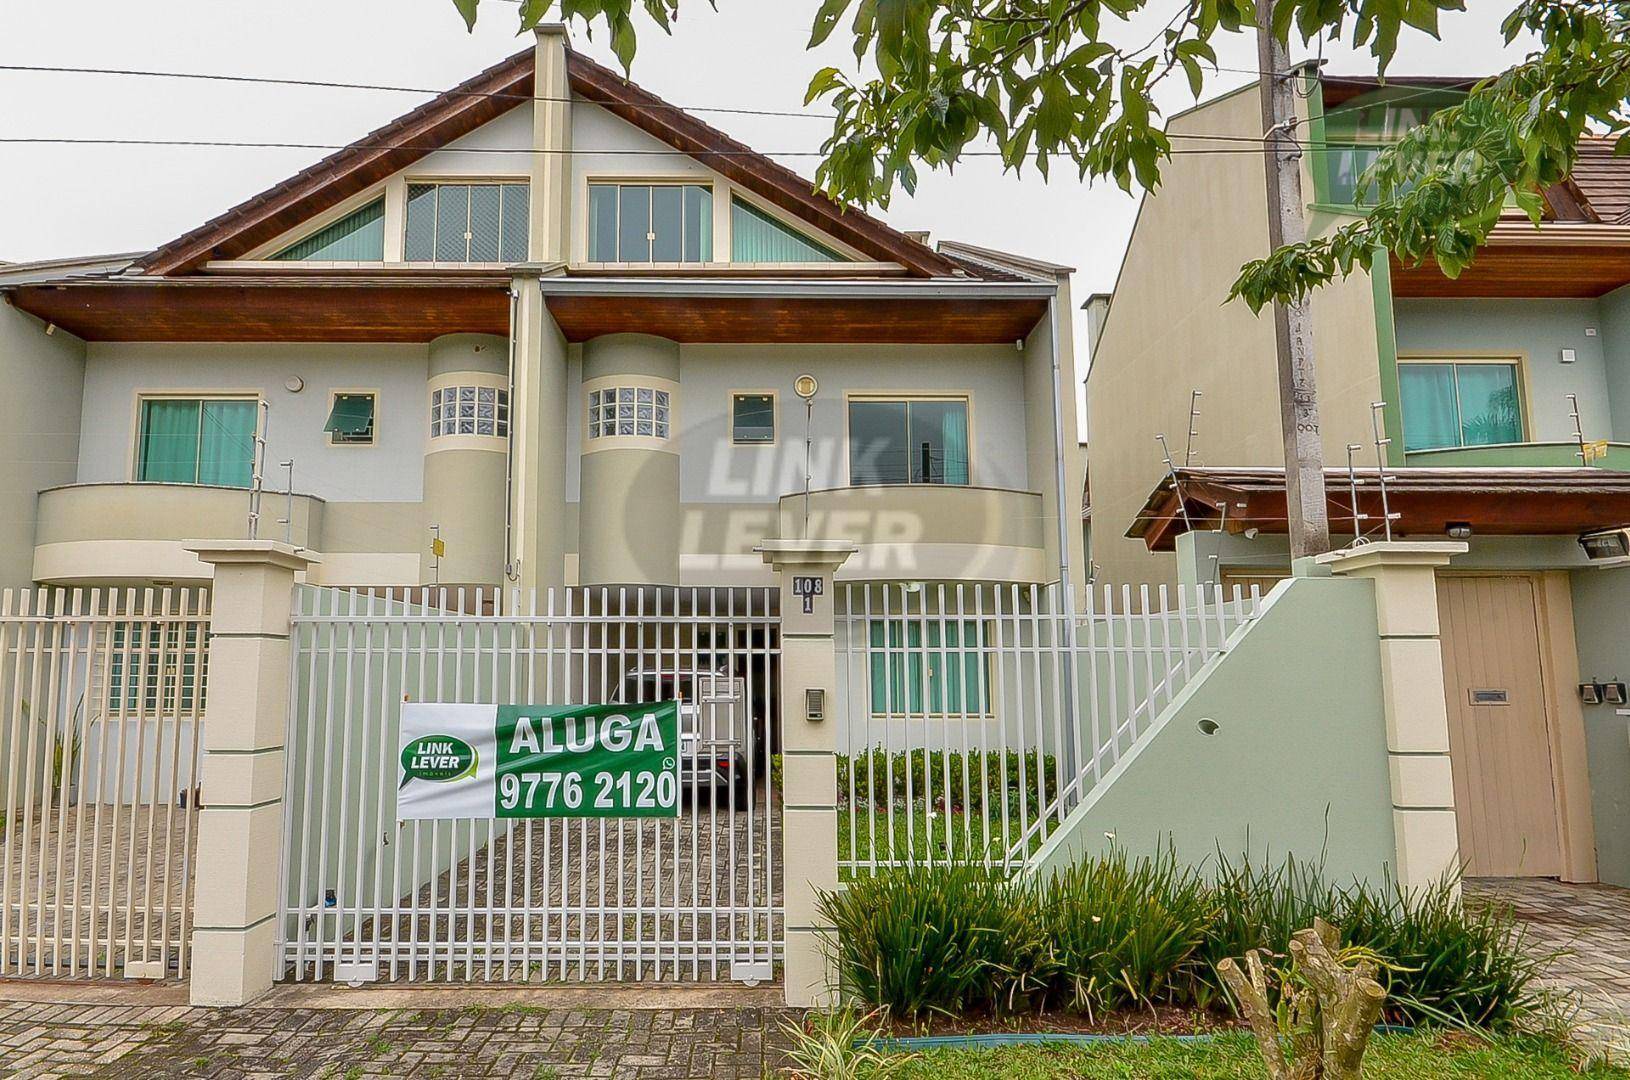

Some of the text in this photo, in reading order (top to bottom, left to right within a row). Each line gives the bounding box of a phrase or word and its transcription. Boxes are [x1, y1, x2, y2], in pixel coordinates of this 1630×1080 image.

[794, 578, 822, 593] 108
[509, 713, 665, 753] ALUGA
[416, 741, 453, 755] LINK
[410, 755, 460, 770] LEVER
[500, 770, 676, 809] 9776 2120
